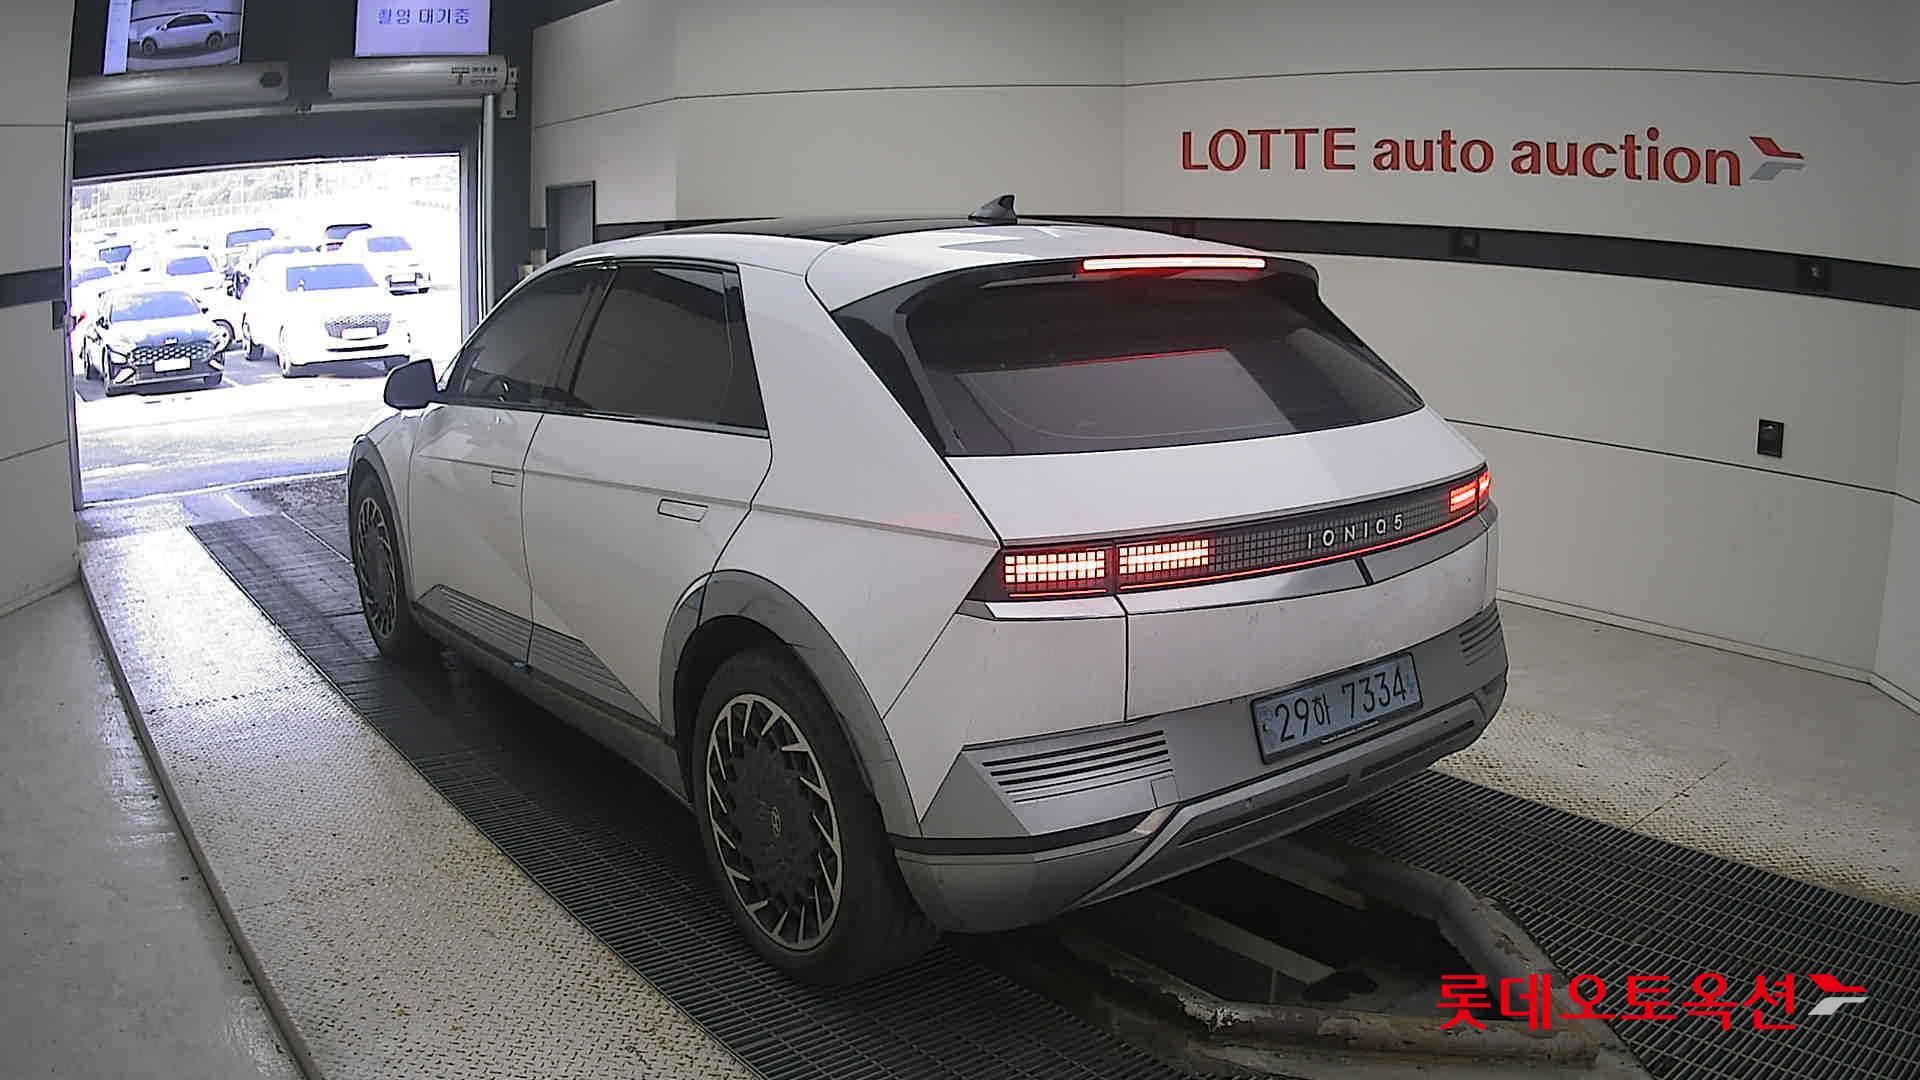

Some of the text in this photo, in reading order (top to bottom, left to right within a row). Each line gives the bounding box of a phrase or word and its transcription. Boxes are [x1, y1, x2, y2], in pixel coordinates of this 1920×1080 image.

[419, 8, 470, 25] 대기중
[1181, 127, 1742, 186] LOTTE auto auction
[1274, 665, 1407, 743] 29하 7334
